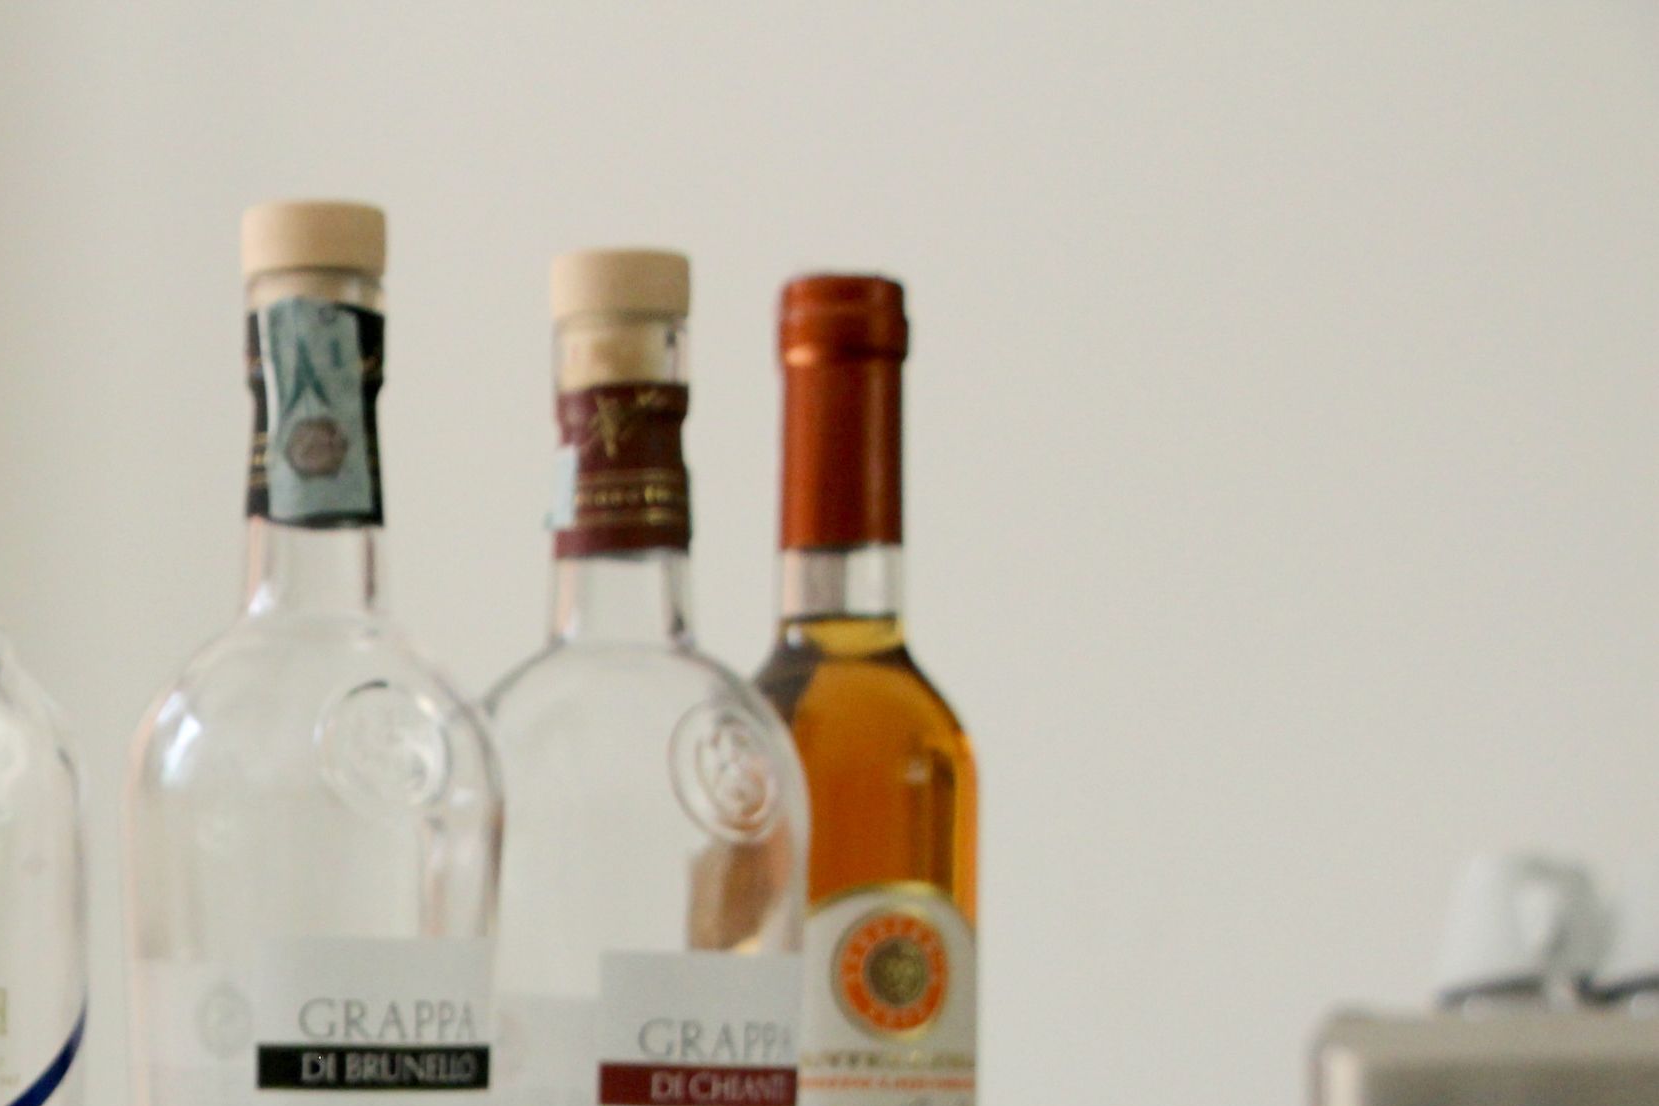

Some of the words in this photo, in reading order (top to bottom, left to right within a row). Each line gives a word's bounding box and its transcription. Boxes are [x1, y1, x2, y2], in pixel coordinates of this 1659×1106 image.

[298, 997, 478, 1041] GRAPPA
[301, 1051, 338, 1081] DI
[345, 1051, 478, 1082] BRUNELLO
[651, 1071, 684, 1099] DI
